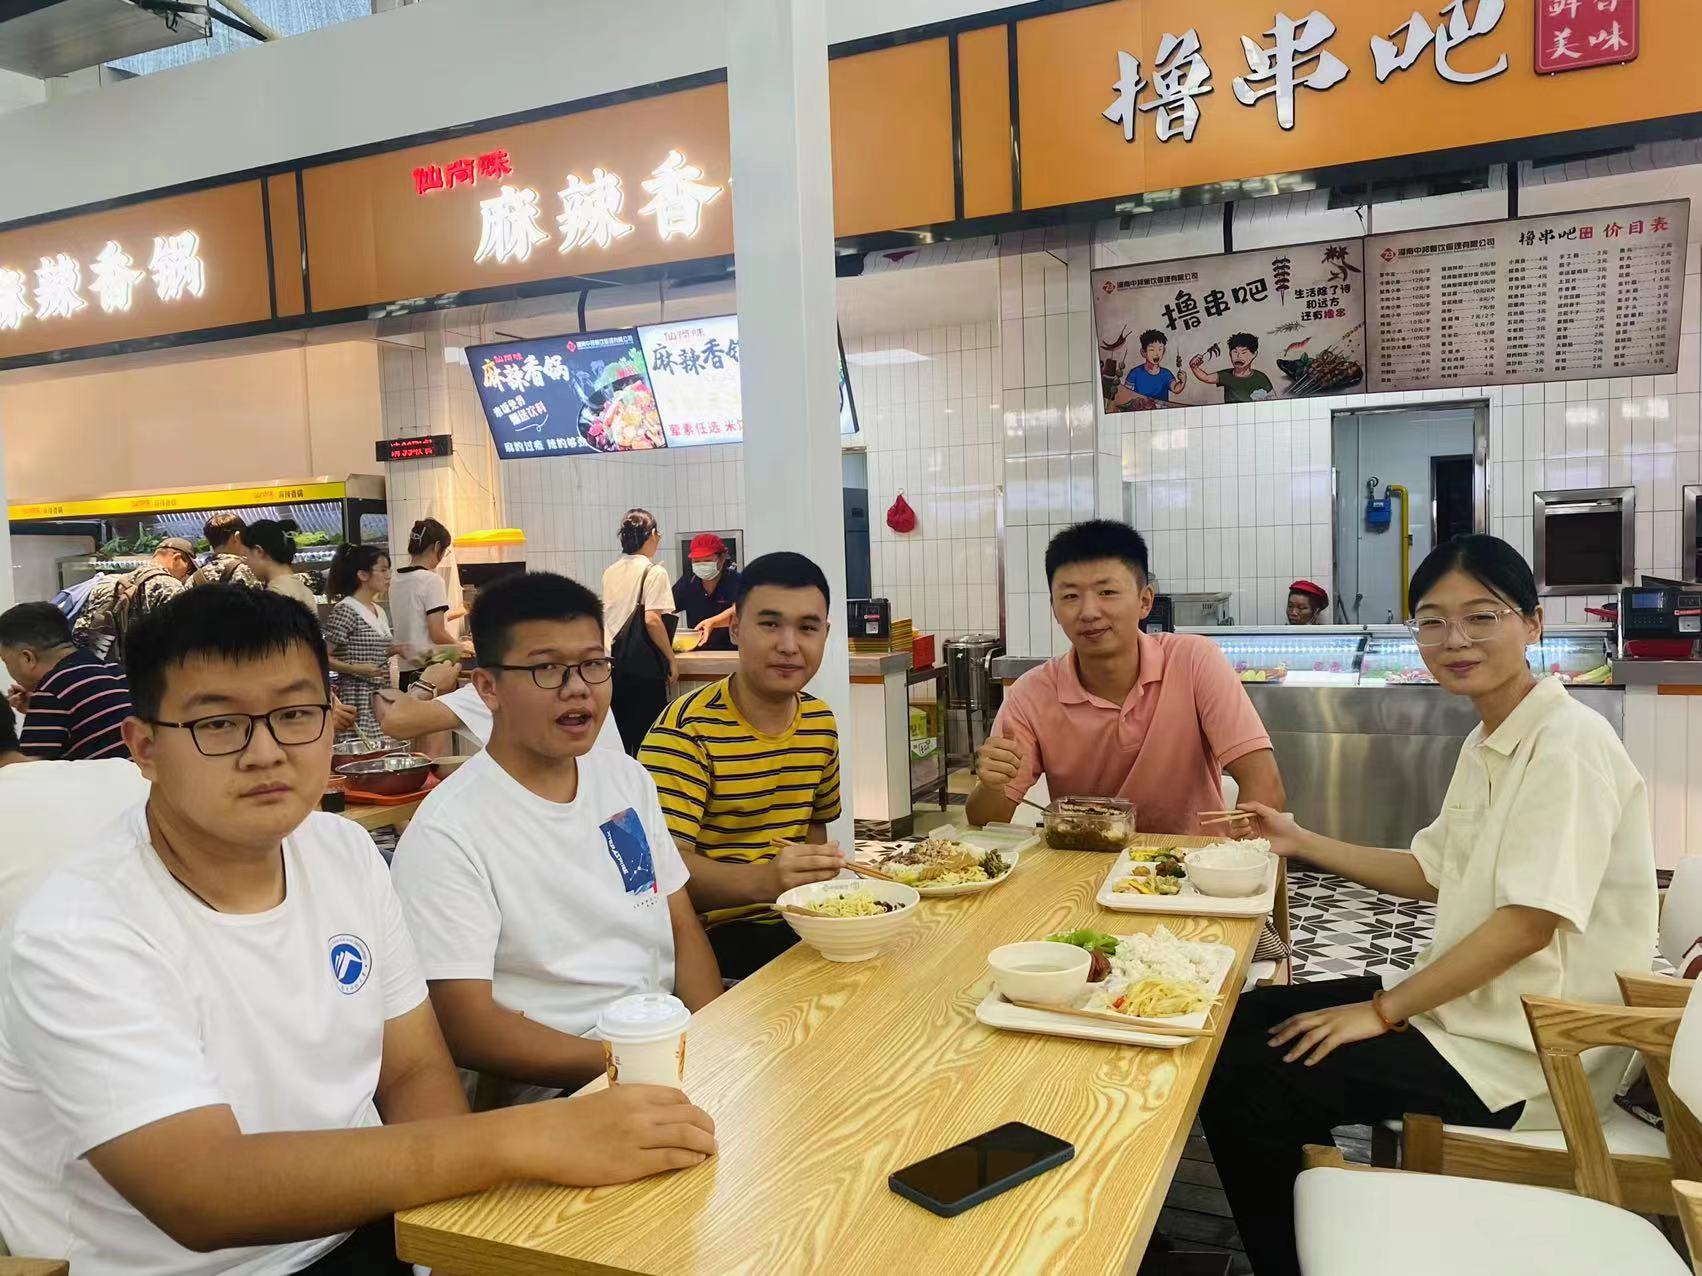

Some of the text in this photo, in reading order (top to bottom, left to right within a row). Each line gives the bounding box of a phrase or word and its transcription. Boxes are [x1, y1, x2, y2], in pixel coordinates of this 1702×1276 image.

[1545, 20, 1629, 59] 美味
[1102, 0, 1508, 143] 撸串吧
[474, 149, 733, 263] 麻辣香
[1519, 226, 1577, 246] 撸串吧
[1602, 217, 1669, 239] 价目表
[1162, 278, 1268, 331] 撸串吧
[1294, 284, 1351, 299] 生活除了诗
[1306, 297, 1340, 309] 和远方
[482, 354, 570, 392] 麻辣香锅
